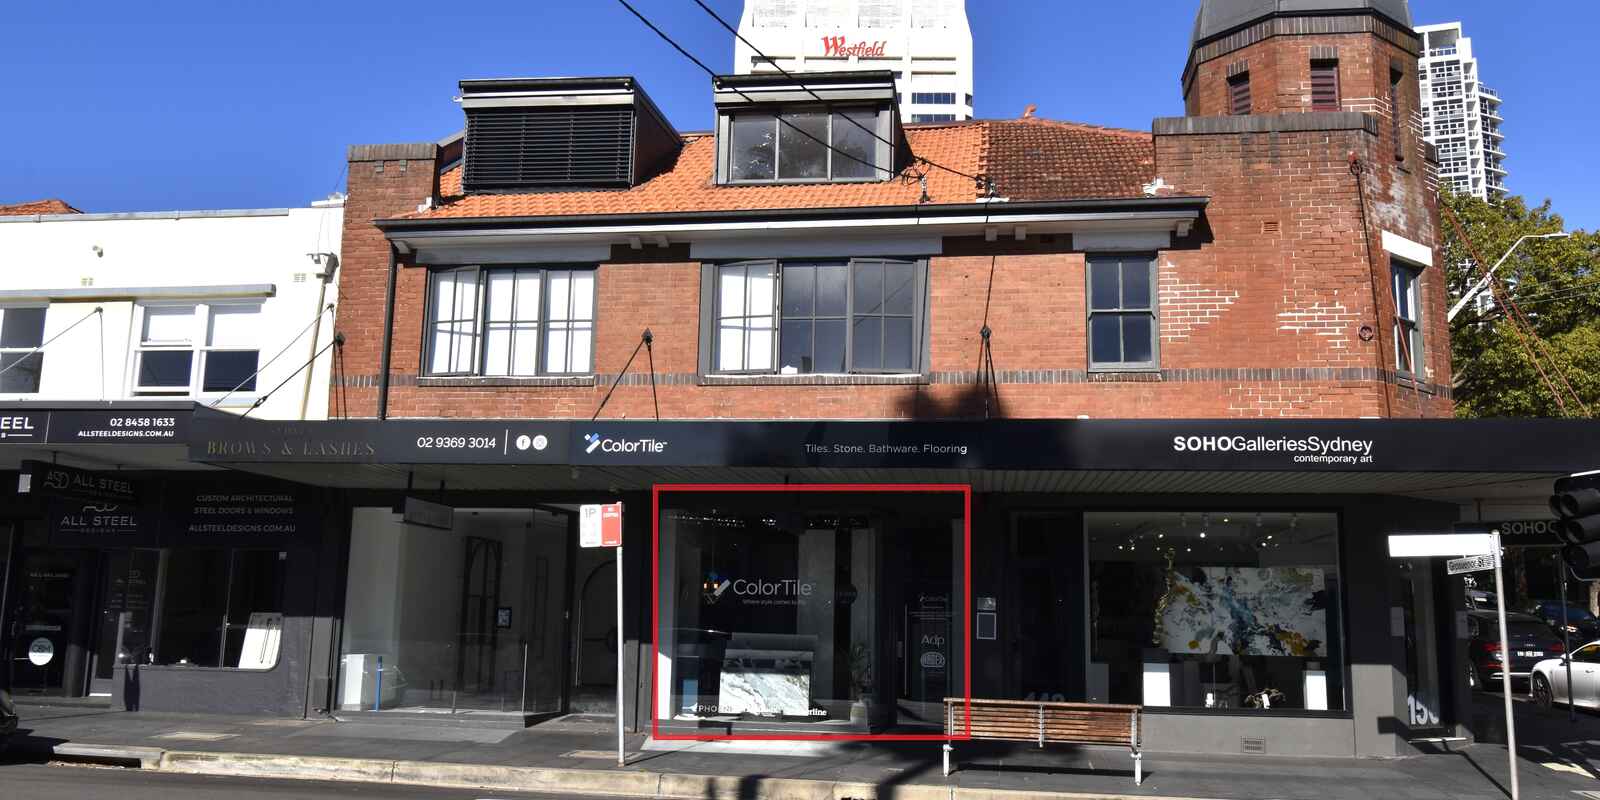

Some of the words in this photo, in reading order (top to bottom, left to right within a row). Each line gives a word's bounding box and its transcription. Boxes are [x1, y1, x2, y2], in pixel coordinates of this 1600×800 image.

[821, 35, 887, 57] Westfield
[0, 416, 35, 431] EEL
[110, 417, 123, 427] 02
[125, 417, 150, 427] 8458
[152, 417, 175, 427] 1633
[78, 430, 175, 438] ALLSTEELDESIGNS.COM.AU
[416, 437, 433, 449] 02
[435, 437, 466, 449] 9369
[467, 437, 497, 449] 3014
[806, 443, 829, 454] Tiles.
[833, 443, 866, 454] Stone.
[869, 443, 920, 454] Bathware.
[923, 443, 968, 455] Flooring
[1173, 435, 1373, 456] SOHOGalleriesSydney
[1293, 454, 1357, 465] contemporary
[1360, 454, 1373, 463] art
[72, 473, 95, 488] ALL
[61, 515, 87, 526] ALL
[93, 515, 136, 526] STEEL
